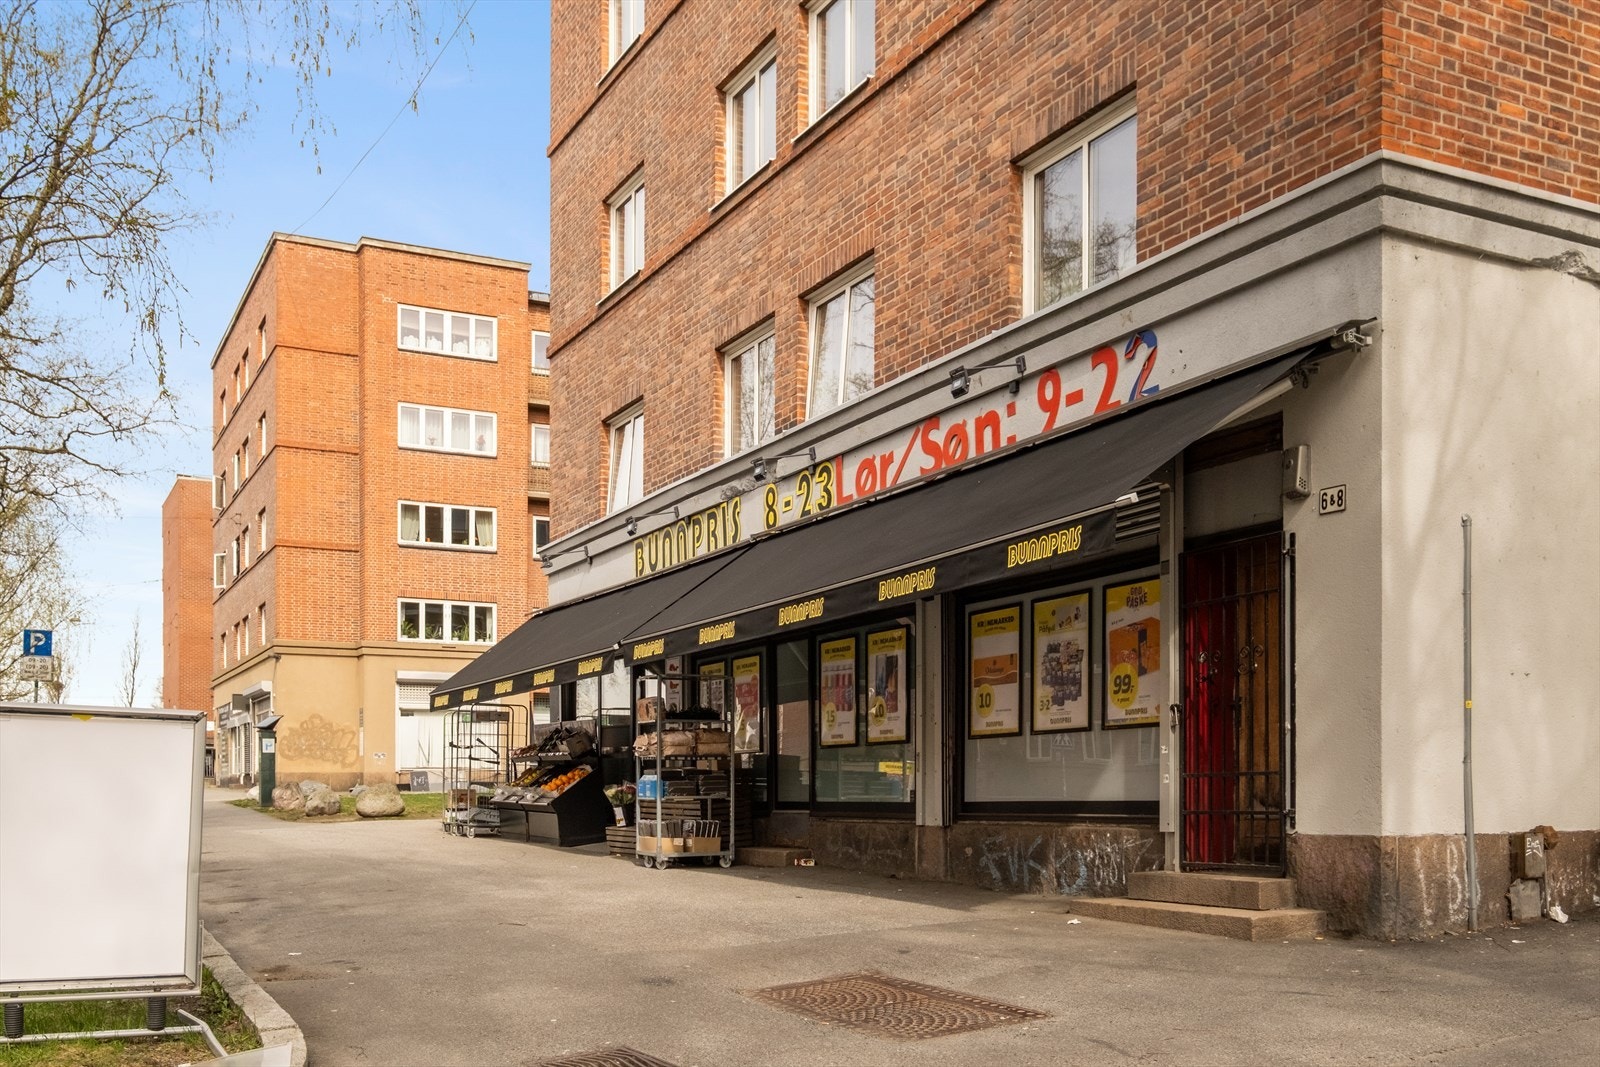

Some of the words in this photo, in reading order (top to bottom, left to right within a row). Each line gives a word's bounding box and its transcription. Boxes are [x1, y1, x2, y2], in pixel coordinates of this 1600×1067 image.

[634, 497, 741, 578] BUNNPRIS
[1007, 525, 1083, 568] BUNNPRIS
[878, 566, 936, 602] BUNNPRIS
[777, 599, 825, 627] BUNNPRIS
[978, 692, 992, 709] 10
